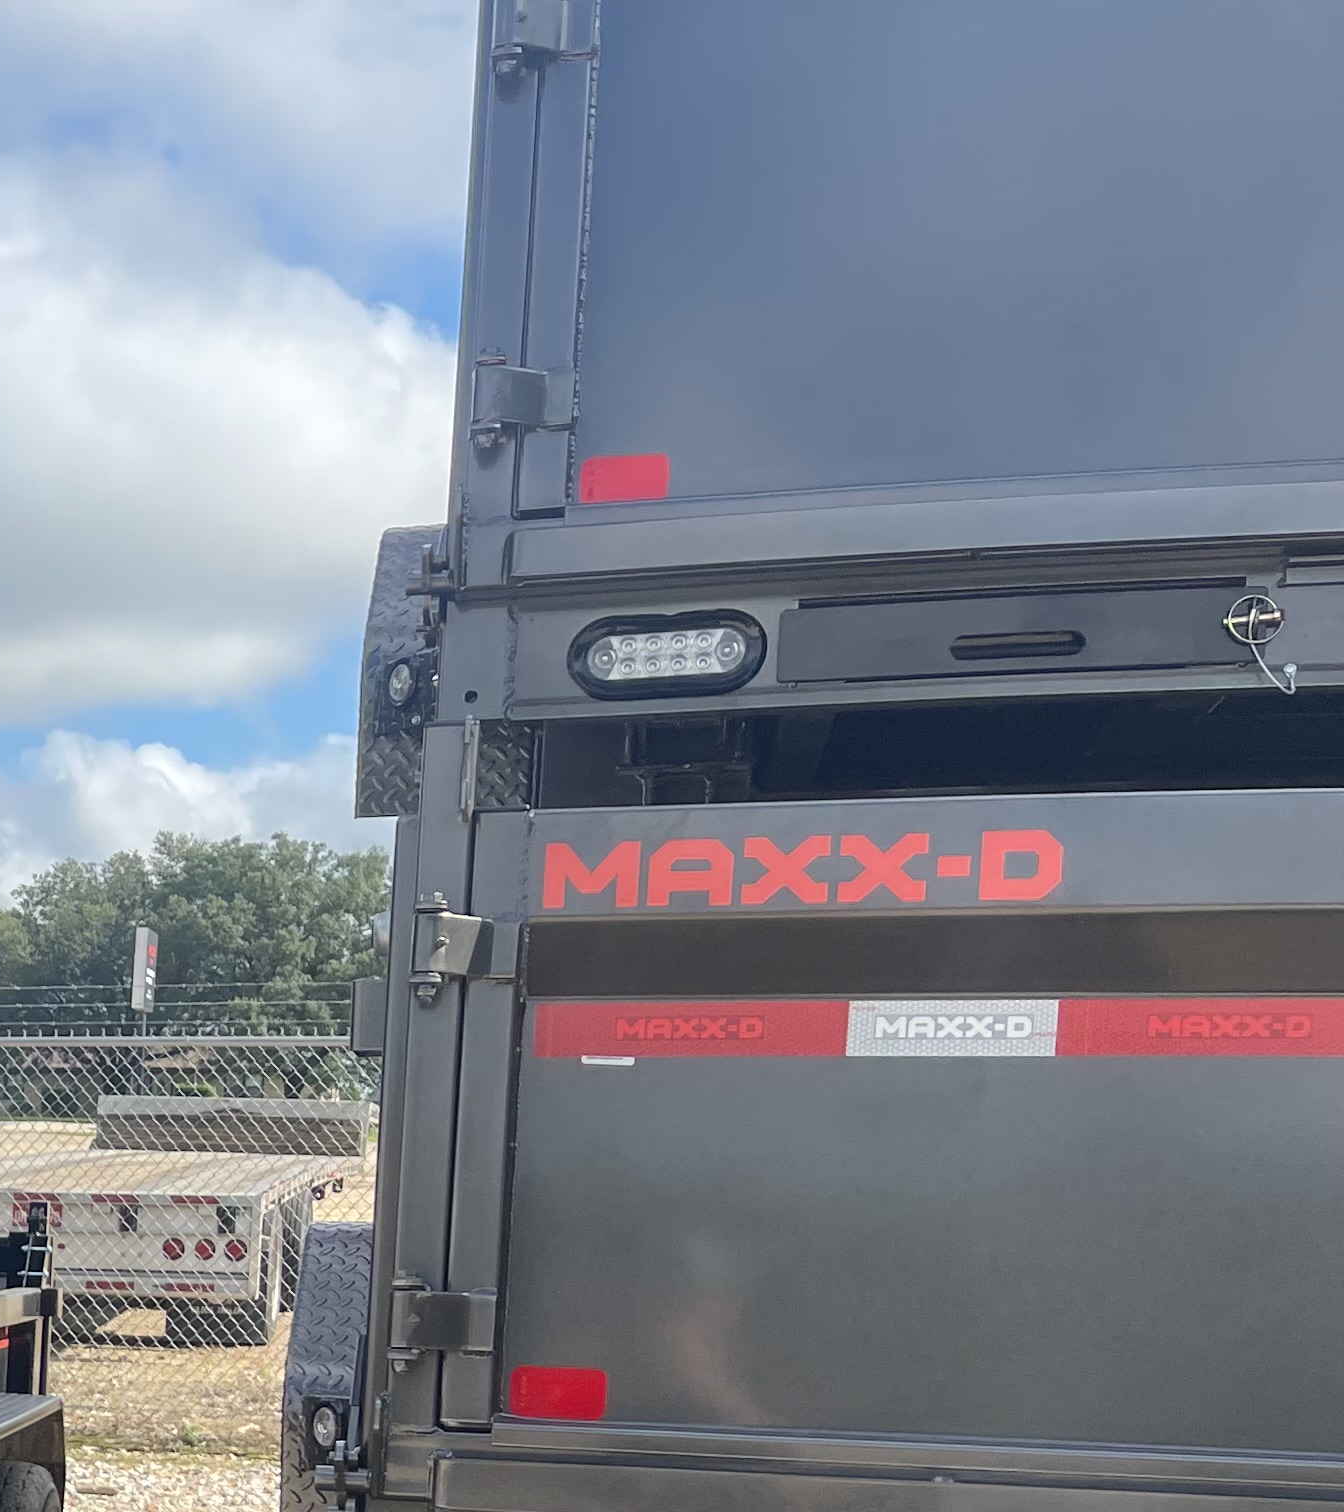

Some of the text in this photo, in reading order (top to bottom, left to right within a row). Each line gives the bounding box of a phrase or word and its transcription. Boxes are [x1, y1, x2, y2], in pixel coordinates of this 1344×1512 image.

[542, 829, 1064, 909] MAXX-D
[616, 1016, 764, 1039] MAXX-D
[874, 1014, 1034, 1039] MAXX-D
[1147, 1014, 1312, 1038] MAXX-D
